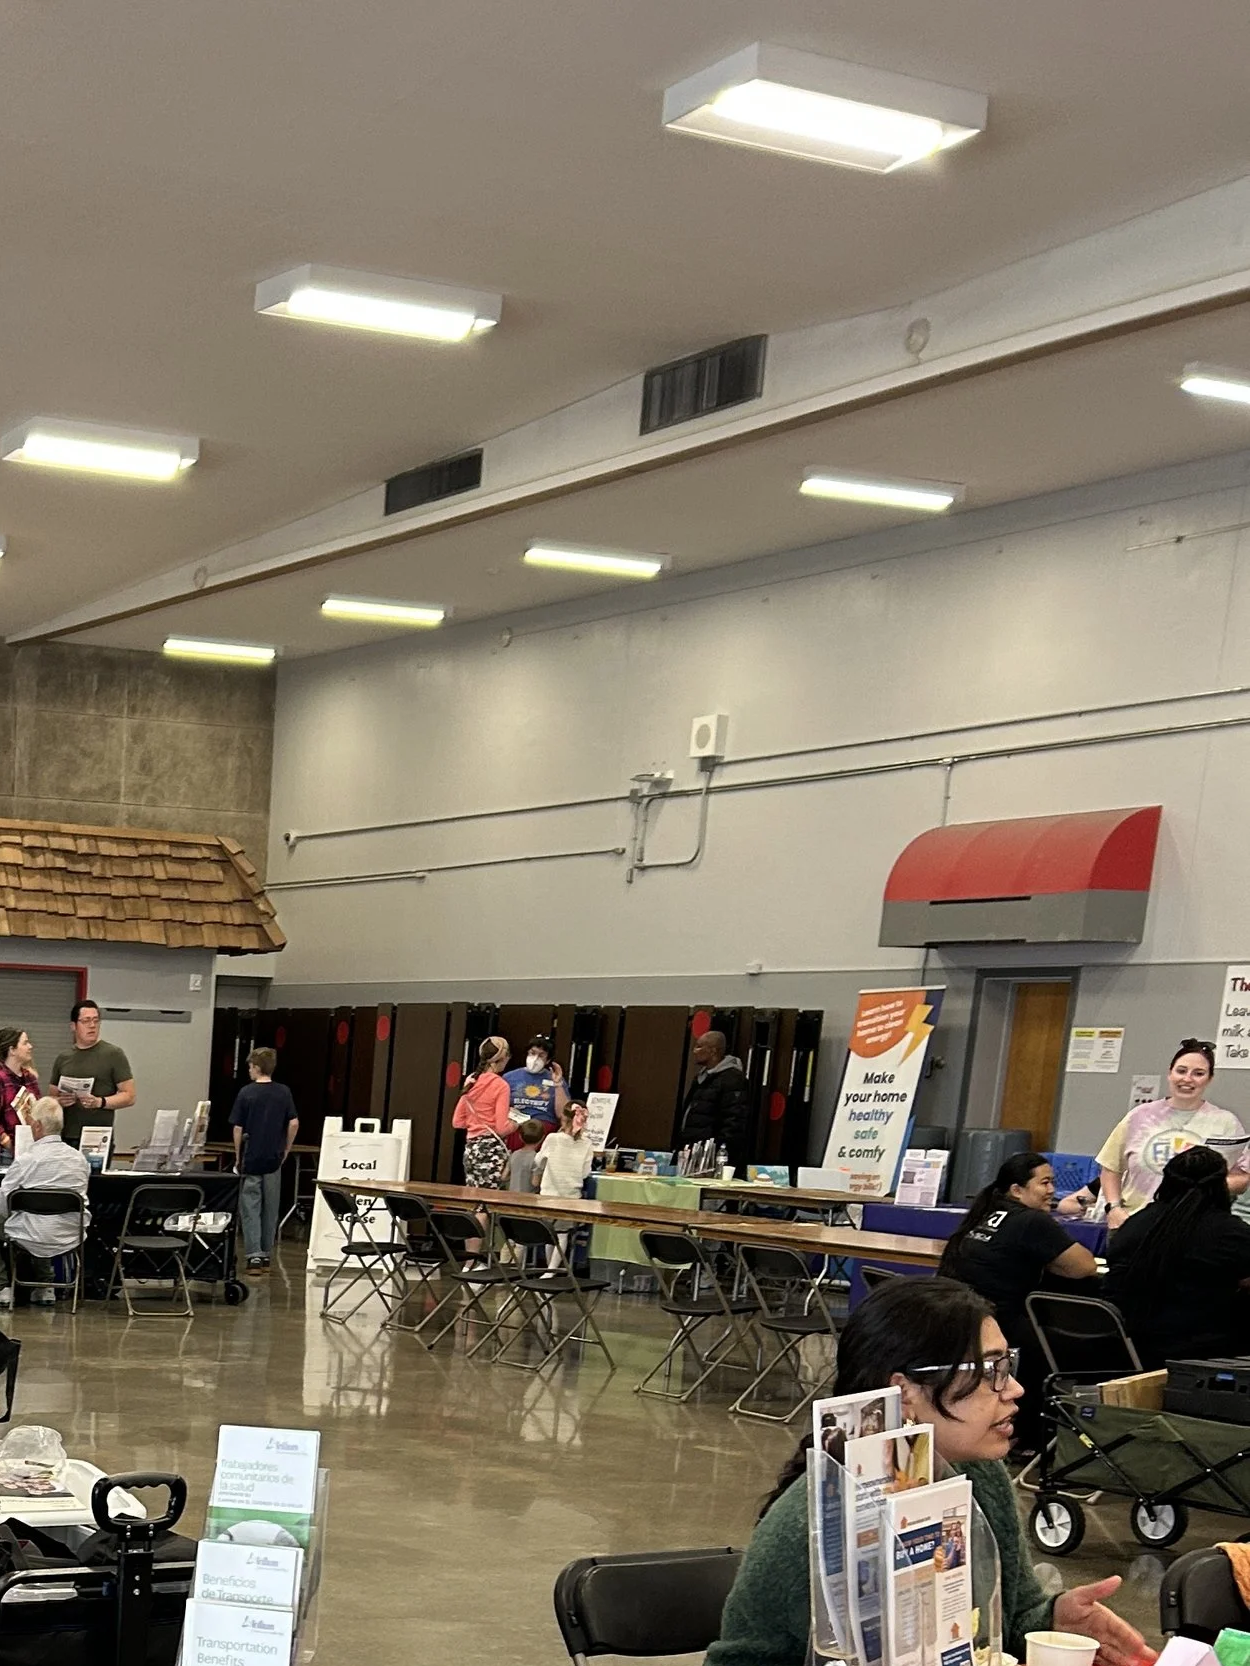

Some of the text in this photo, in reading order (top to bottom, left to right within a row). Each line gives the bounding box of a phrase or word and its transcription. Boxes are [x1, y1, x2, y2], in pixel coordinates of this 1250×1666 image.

[1222, 1024, 1245, 1038] milk
[1225, 1044, 1249, 1058] Take
[863, 1071, 896, 1084] Make
[844, 1090, 908, 1107] your home
[848, 1109, 893, 1125] healthy
[853, 1127, 879, 1140] safe
[837, 1145, 886, 1162] & comfy
[342, 1159, 377, 1170] Local
[356, 1198, 372, 1206] en
[281, 1474, 294, 1484] de
[230, 1483, 255, 1492] salud
[909, 1546, 914, 1556] A
[915, 1540, 935, 1553] HOME?
[202, 1573, 256, 1588] Beneficios
[201, 1588, 273, 1603] de Transporte
[197, 1636, 277, 1655] Transportation
